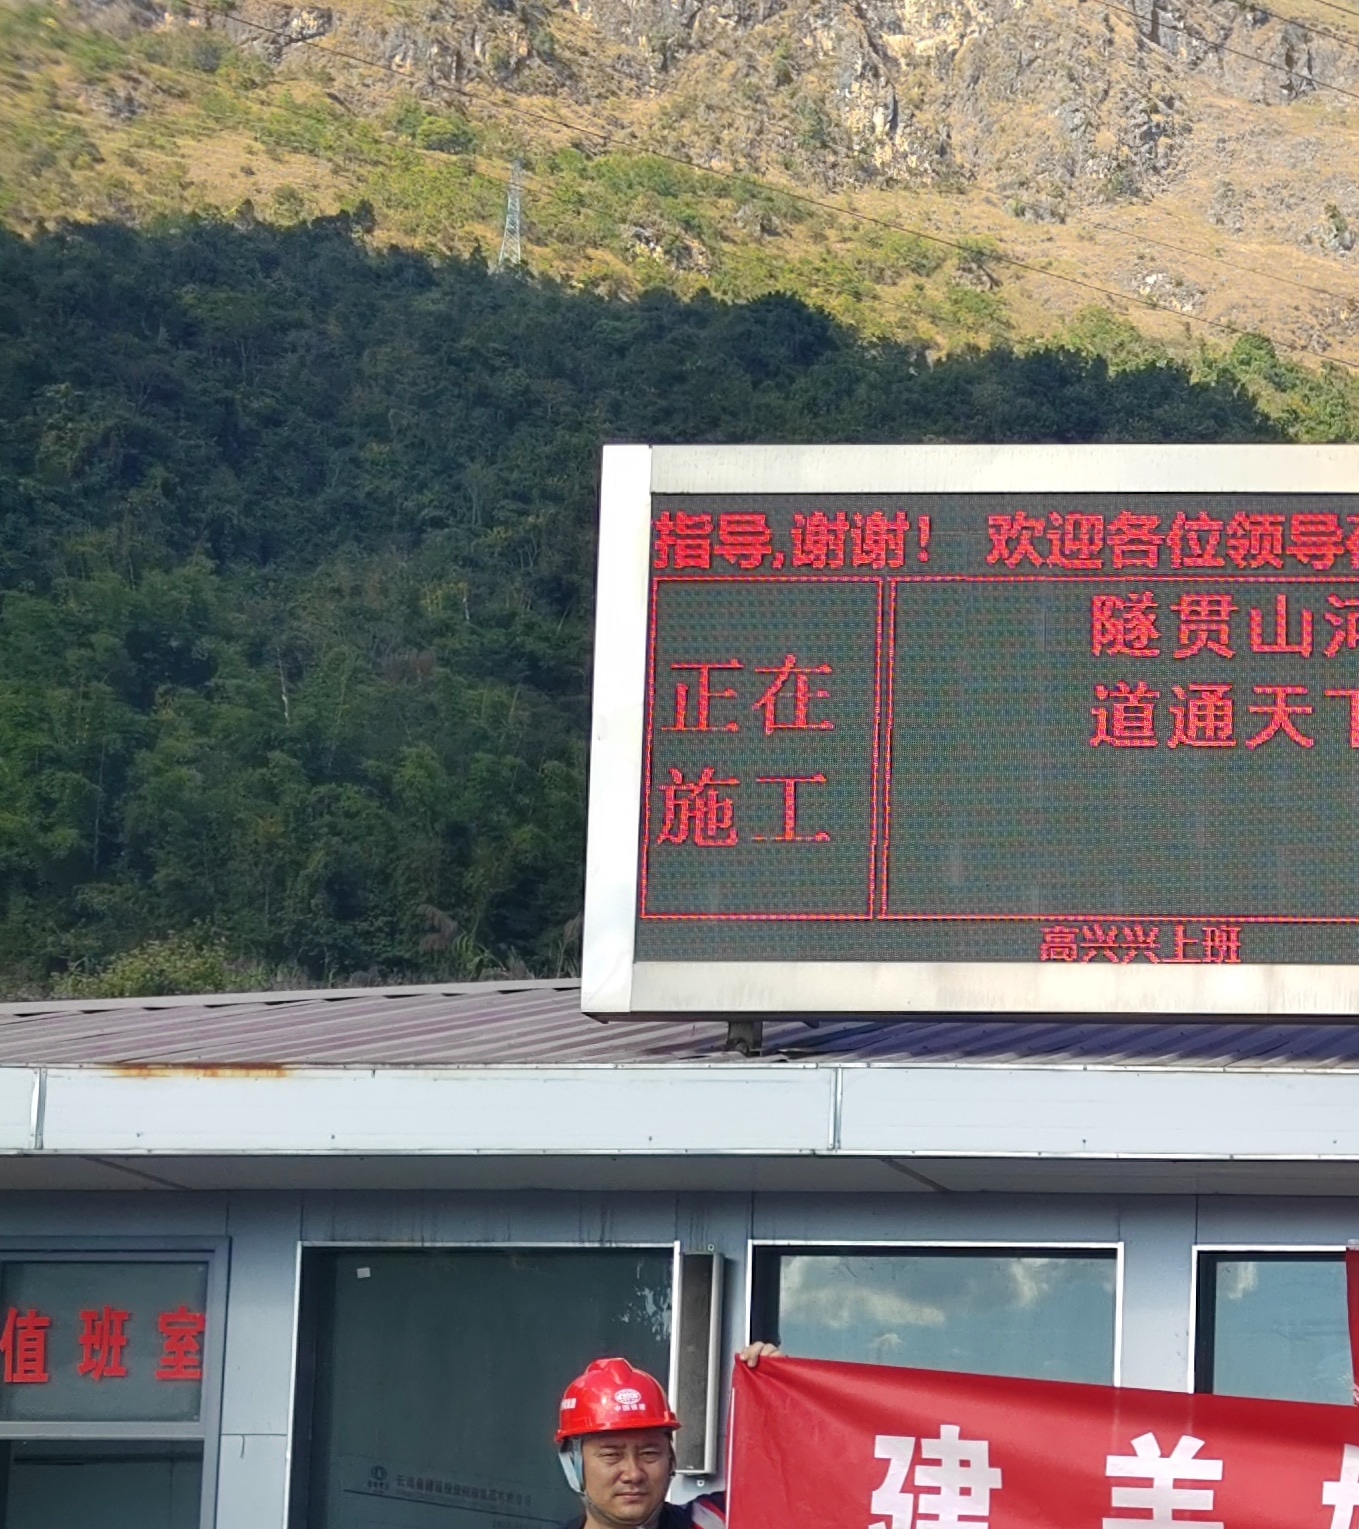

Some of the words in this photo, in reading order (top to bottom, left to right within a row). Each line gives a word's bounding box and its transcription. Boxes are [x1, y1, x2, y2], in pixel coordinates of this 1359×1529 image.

[660, 652, 835, 734] 正在
[655, 767, 832, 847] 施工
[1040, 924, 1242, 964] 高兴兴上班
[0, 1305, 206, 1383] 值班室
